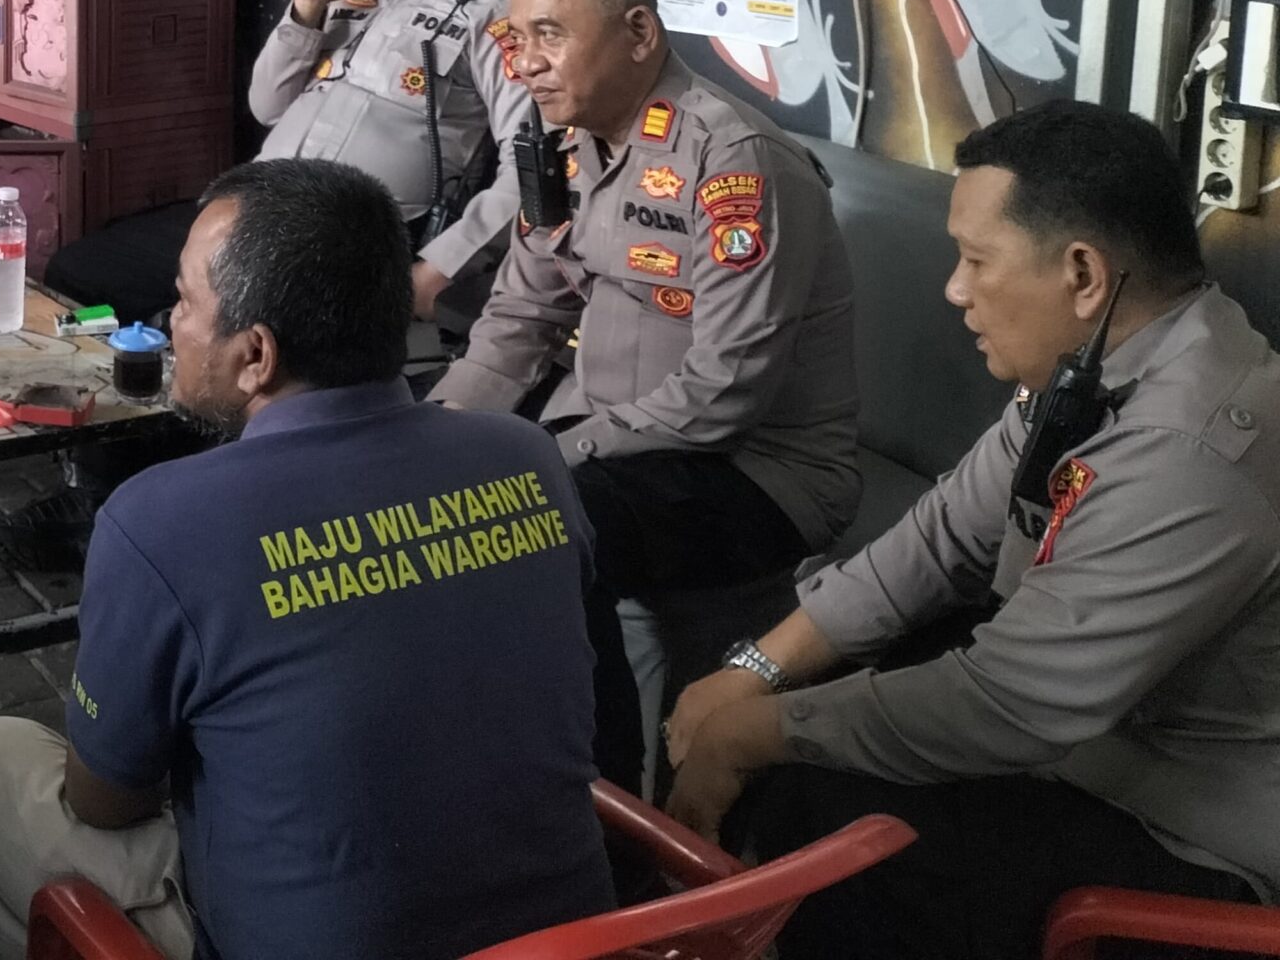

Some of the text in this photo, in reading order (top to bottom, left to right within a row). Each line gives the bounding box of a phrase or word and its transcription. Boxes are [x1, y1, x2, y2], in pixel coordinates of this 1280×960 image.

[412, 13, 467, 40] POLRI
[701, 176, 757, 197] POLSEK
[624, 201, 689, 235] POLRI
[260, 472, 548, 572] MAJU WILAYAHNYE
[261, 510, 568, 619] BAHAGIA WARGANYE
